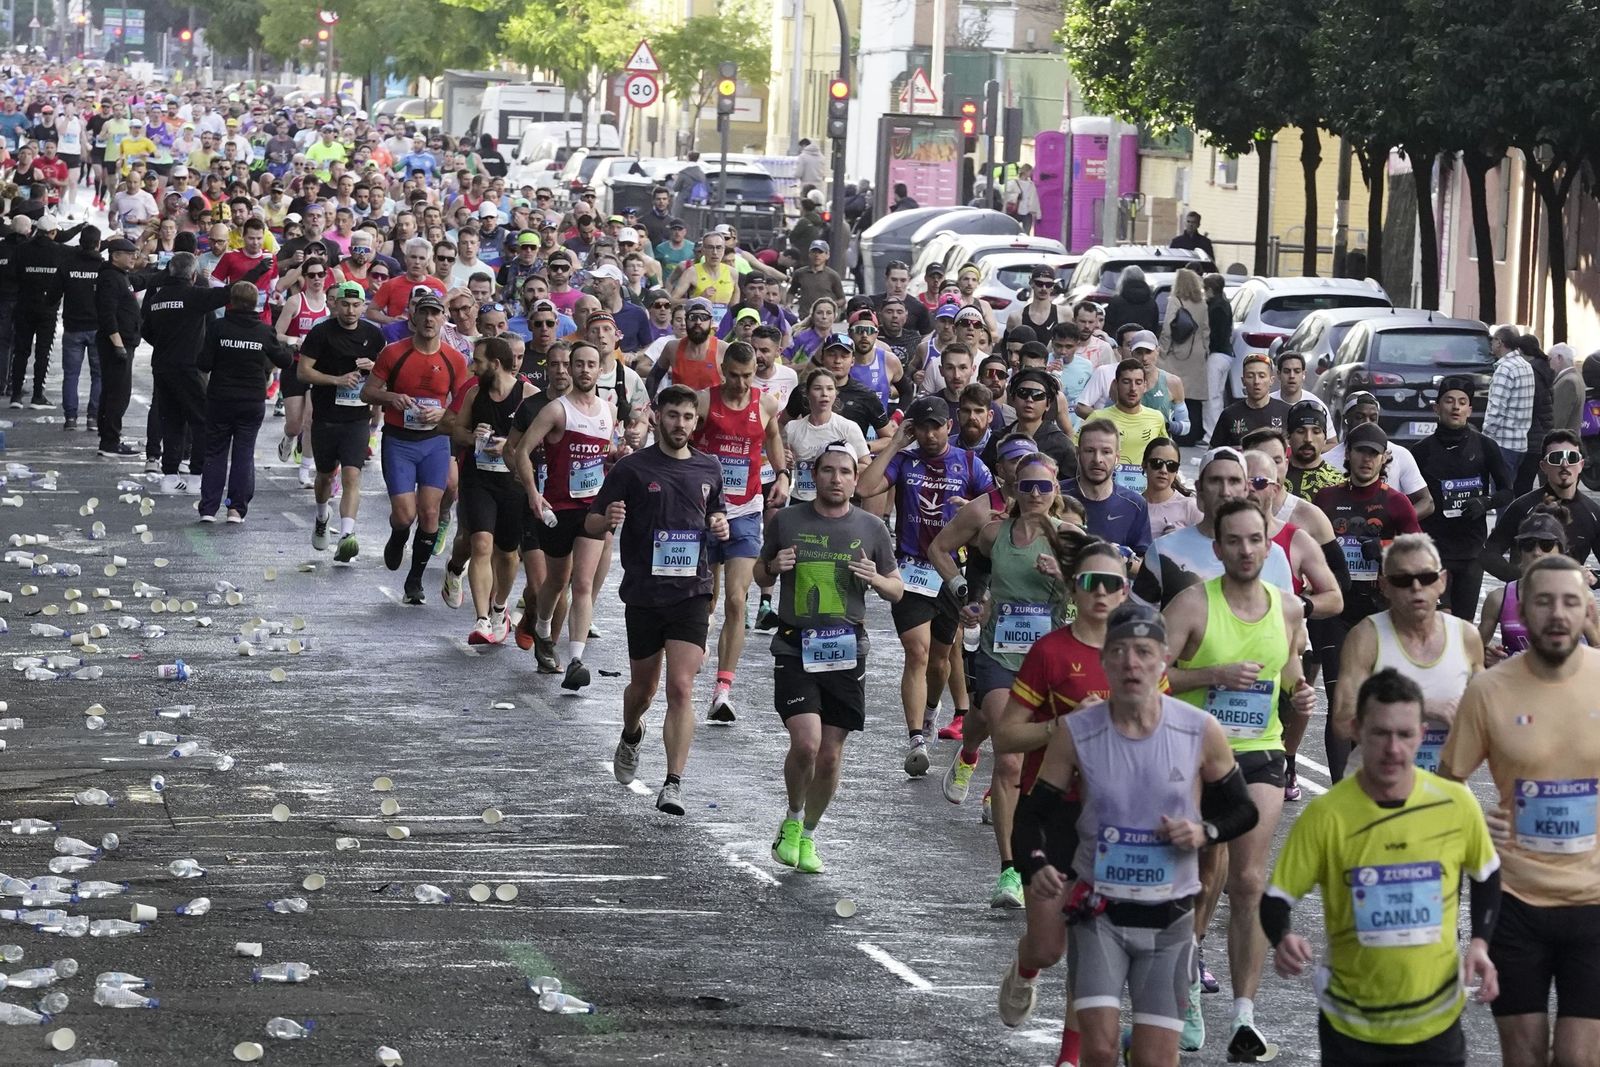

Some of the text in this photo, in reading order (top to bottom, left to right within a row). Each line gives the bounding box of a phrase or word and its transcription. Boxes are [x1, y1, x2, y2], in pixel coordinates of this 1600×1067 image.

[632, 84, 652, 96] 30
[150, 300, 184, 311] VOLUNTEER
[220, 338, 262, 350] VOLUNTEER
[528, 371, 542, 380] edp
[569, 443, 600, 454] GETXO
[922, 480, 960, 492] MAVEN
[664, 555, 692, 566] DAVID
[1348, 560, 1372, 570] RIAN
[908, 576, 928, 586] TONI
[1014, 606, 1044, 614] ZURICH
[1004, 630, 1040, 642] NICOLE
[814, 650, 845, 660] EL JEJ
[1210, 709, 1264, 724] PAREDES
[1543, 783, 1590, 795] ZURICH
[1106, 866, 1165, 882] ROPERO
[1383, 866, 1432, 882] ZURICH
[1371, 907, 1430, 928] CANIJO
